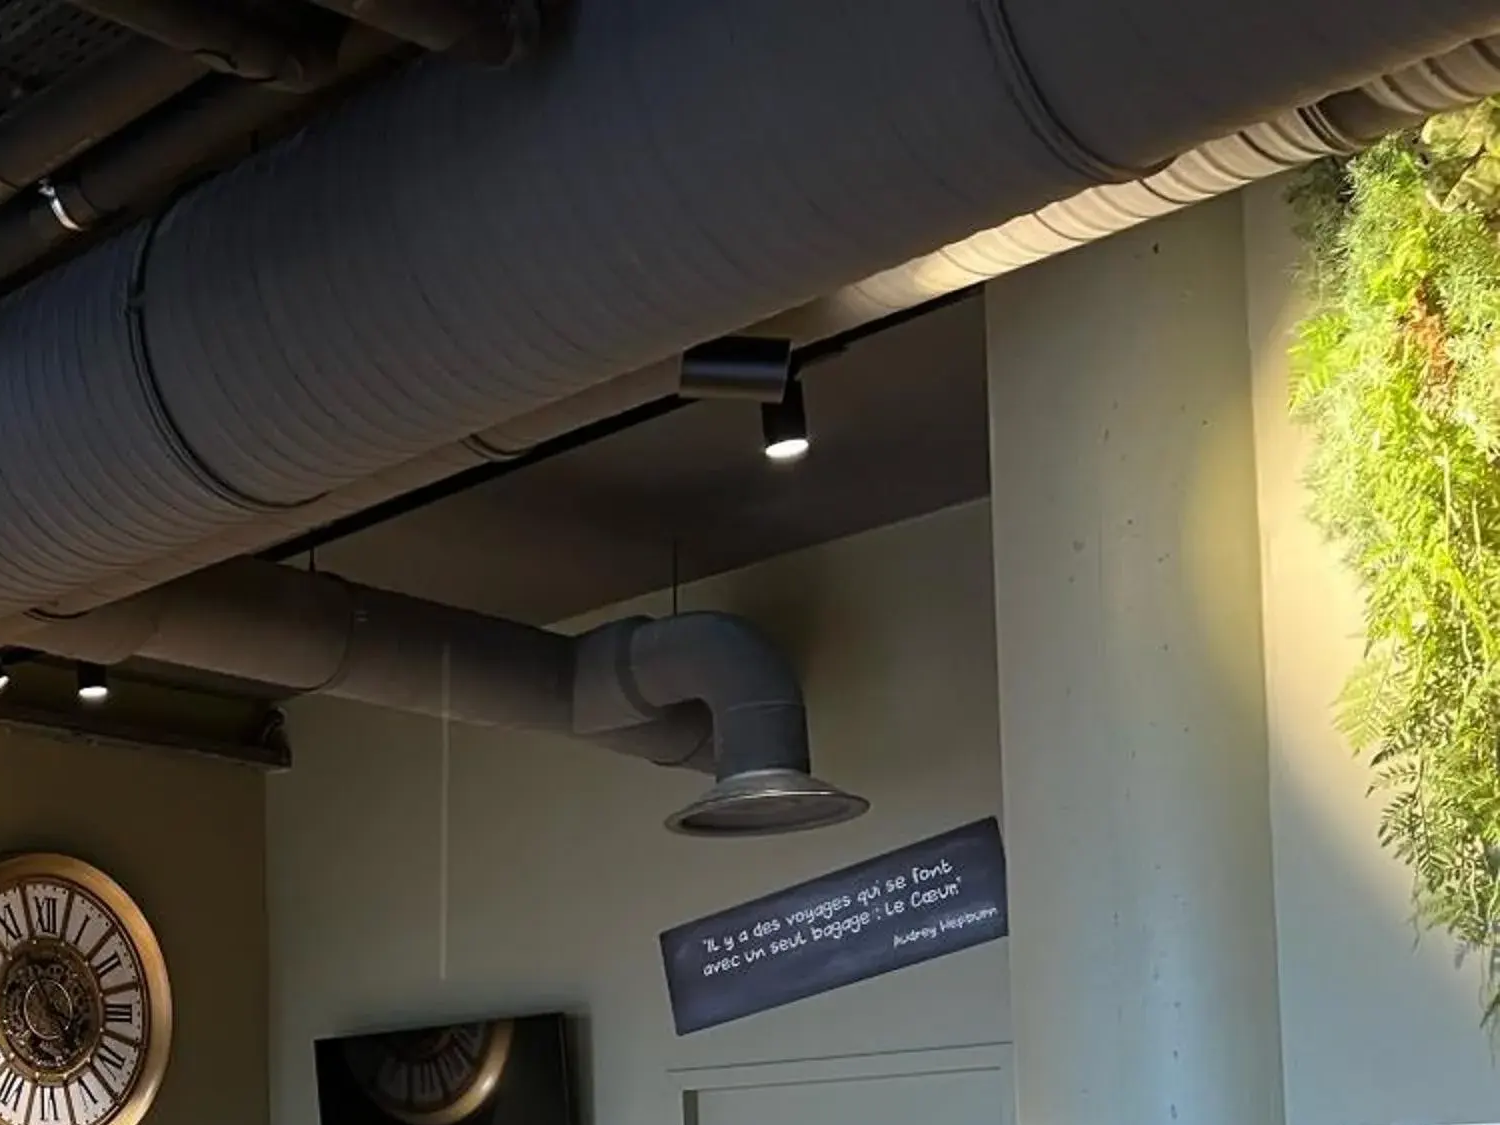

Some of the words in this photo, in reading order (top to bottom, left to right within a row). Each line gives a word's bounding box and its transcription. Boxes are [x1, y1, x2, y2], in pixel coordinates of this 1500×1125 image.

[703, 954, 741, 977] avec
[744, 947, 767, 963] un
[769, 931, 808, 955] seul
[811, 910, 871, 940] bagage
[723, 935, 735, 951] y
[738, 929, 749, 943] a
[753, 917, 781, 938] des
[785, 894, 851, 927] voyages
[857, 879, 882, 907] qui
[885, 875, 907, 893] se
[911, 858, 953, 885] font
